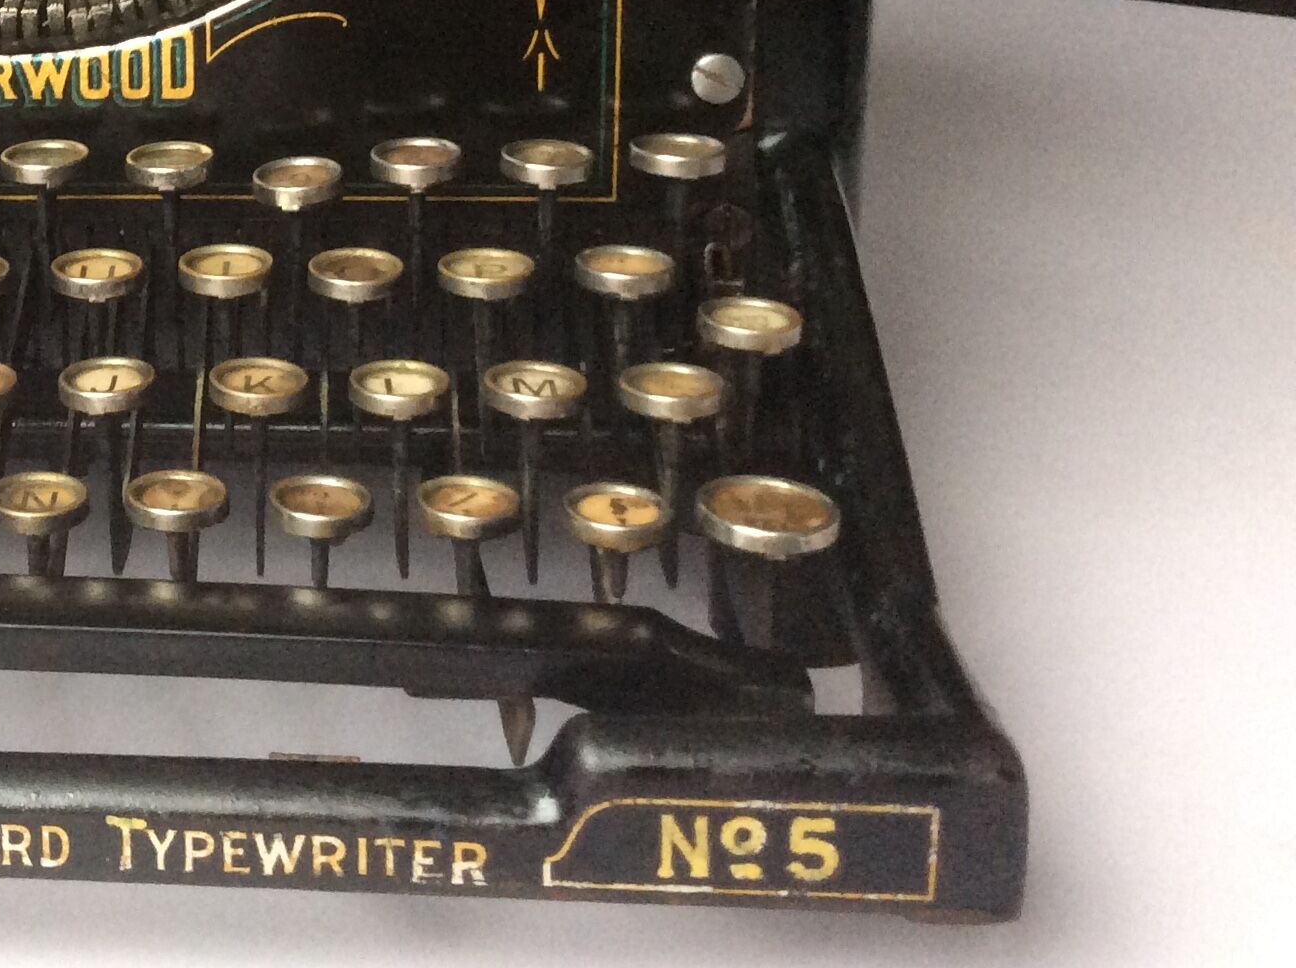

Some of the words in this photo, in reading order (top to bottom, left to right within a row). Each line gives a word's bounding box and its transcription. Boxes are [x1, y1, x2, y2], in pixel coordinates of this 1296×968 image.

[90, 375, 118, 393] J
[243, 375, 275, 394] K
[511, 377, 560, 398] M
[21, 490, 58, 510] N
[106, 817, 490, 886] TYPEWRITER
[787, 817, 841, 882] 5
